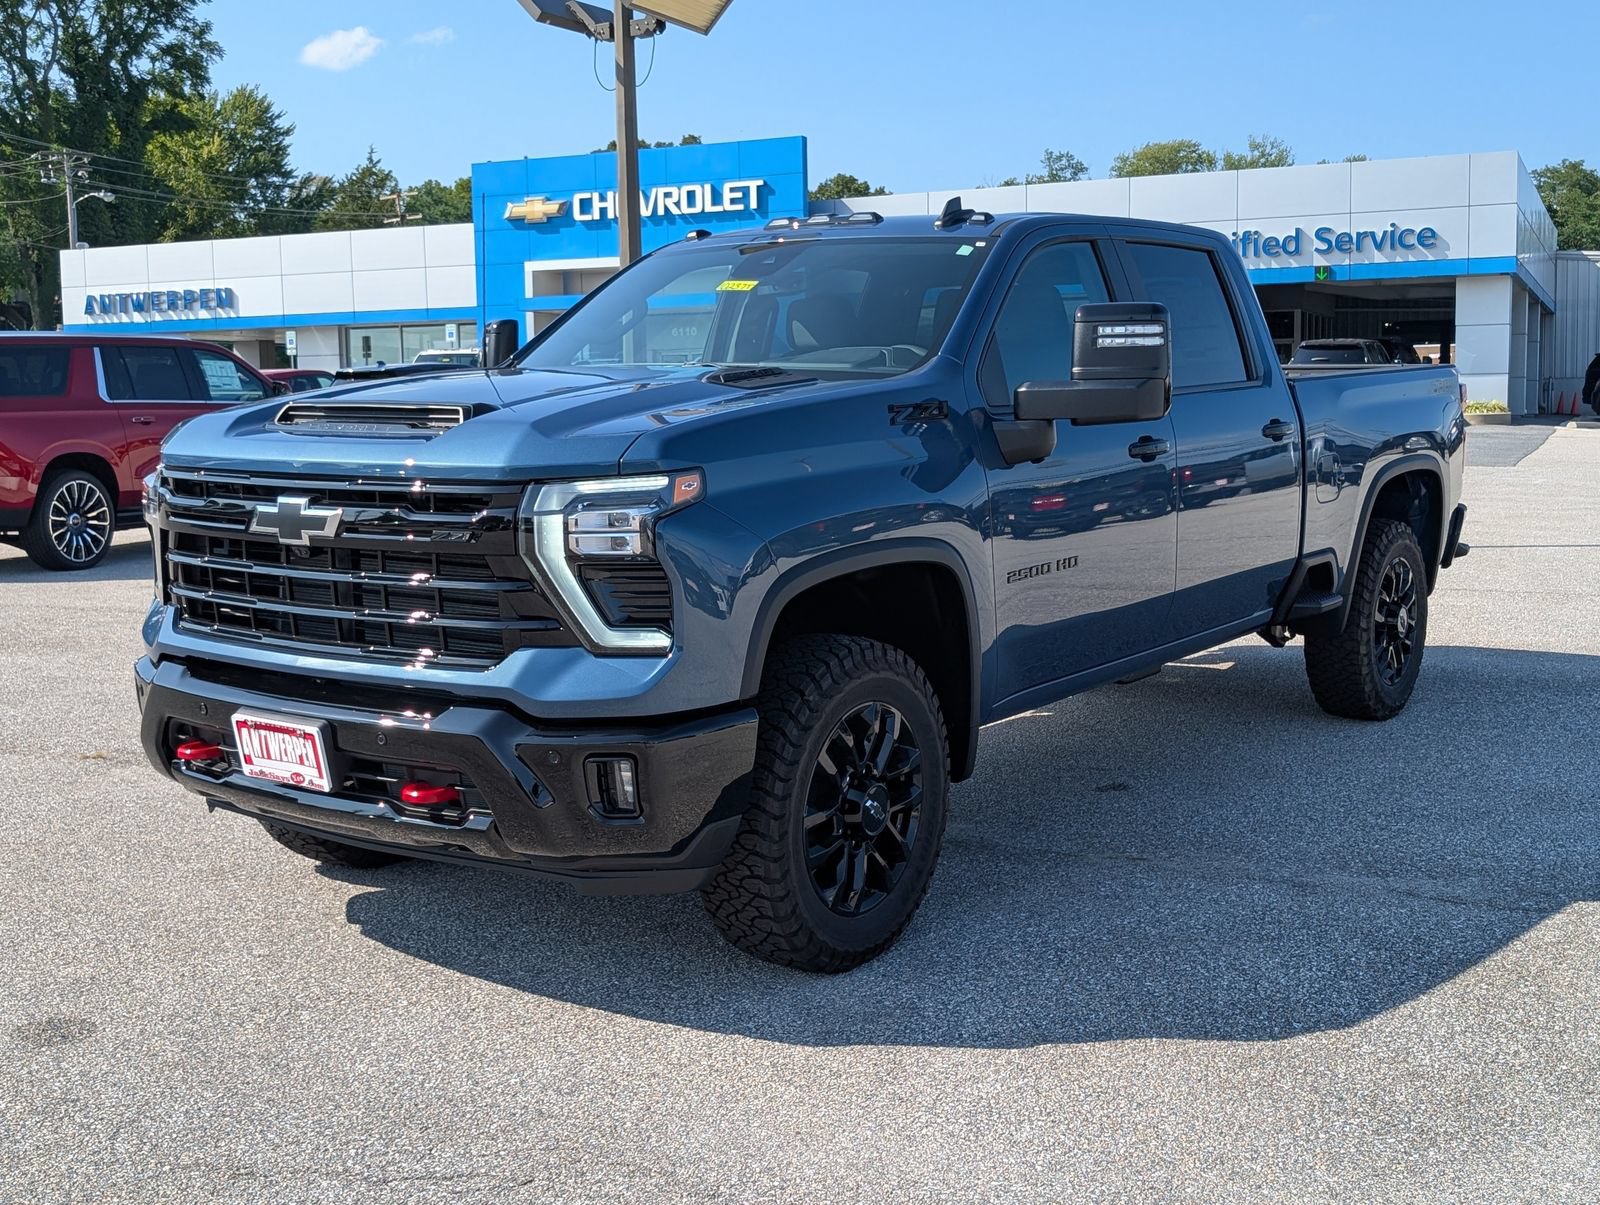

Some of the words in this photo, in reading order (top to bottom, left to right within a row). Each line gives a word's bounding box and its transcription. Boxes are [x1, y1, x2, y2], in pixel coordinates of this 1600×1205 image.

[573, 180, 764, 221] CHVROLET
[1314, 222, 1437, 255] Service
[84, 287, 232, 315] ANTWERPEN
[671, 327, 697, 337] 6110
[1006, 562, 1052, 584] 2500
[1056, 556, 1079, 572] HD
[241, 727, 317, 769] ANTWERPEN
